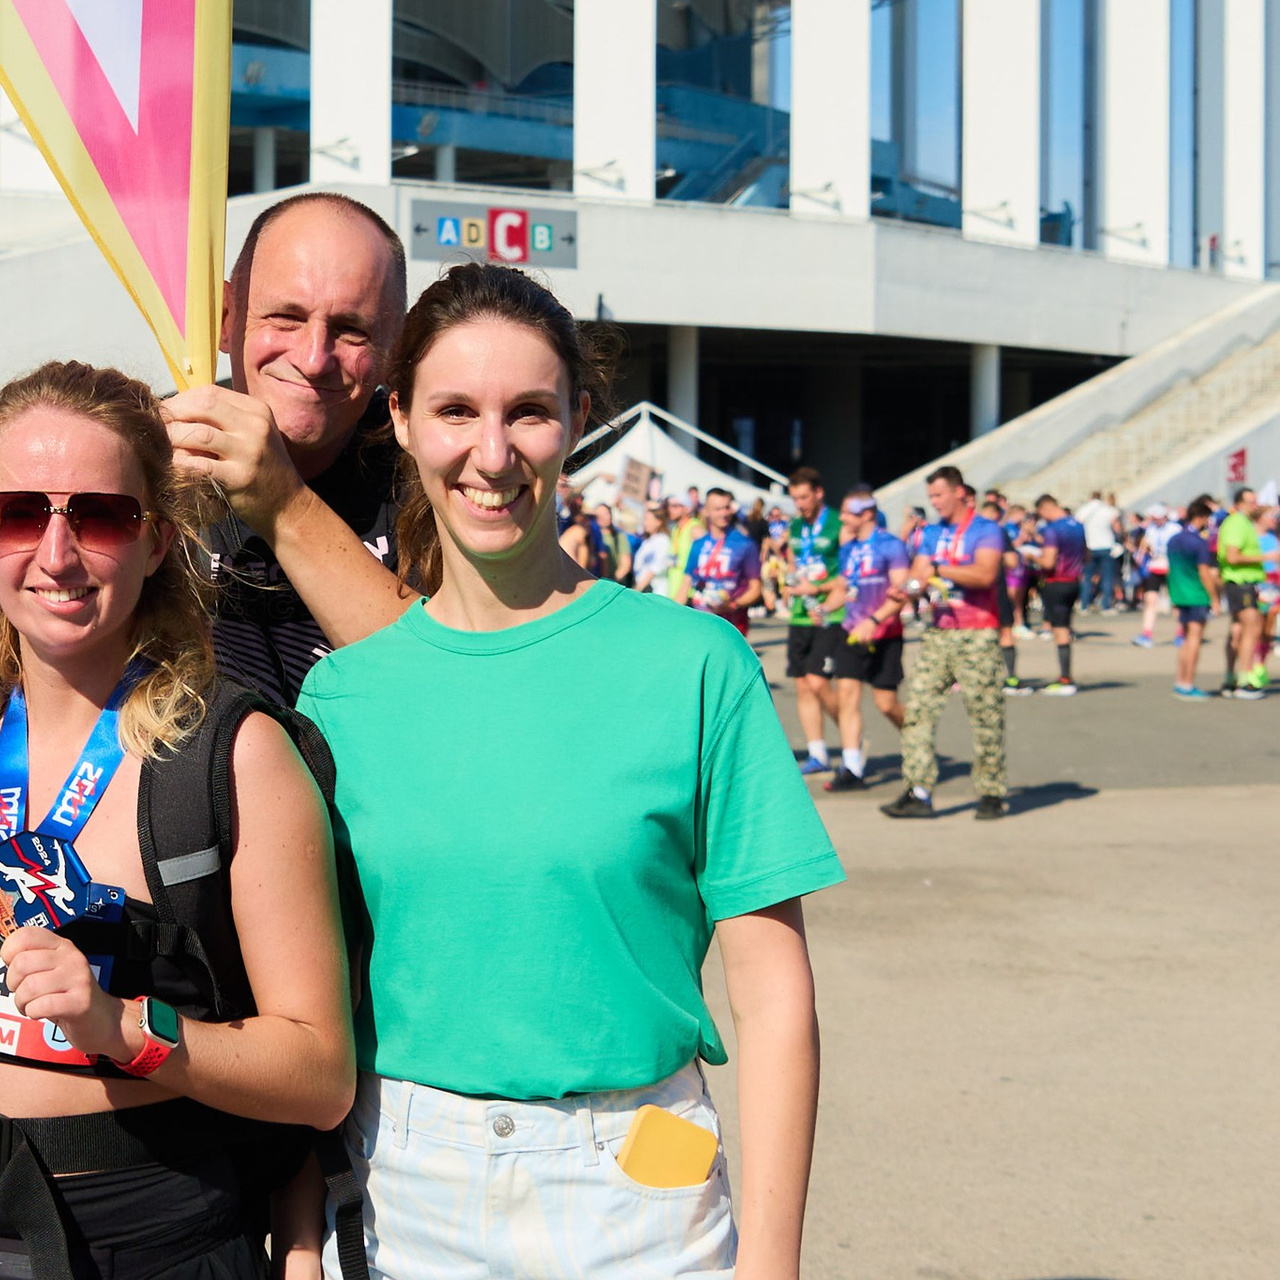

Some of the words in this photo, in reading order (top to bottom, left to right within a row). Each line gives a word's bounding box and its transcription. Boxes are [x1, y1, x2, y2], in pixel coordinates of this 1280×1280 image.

[438, 219, 458, 245] A
[467, 222, 480, 244] D
[494, 211, 523, 260] C
[534, 225, 551, 250] B
[31, 836, 52, 866] 2024
